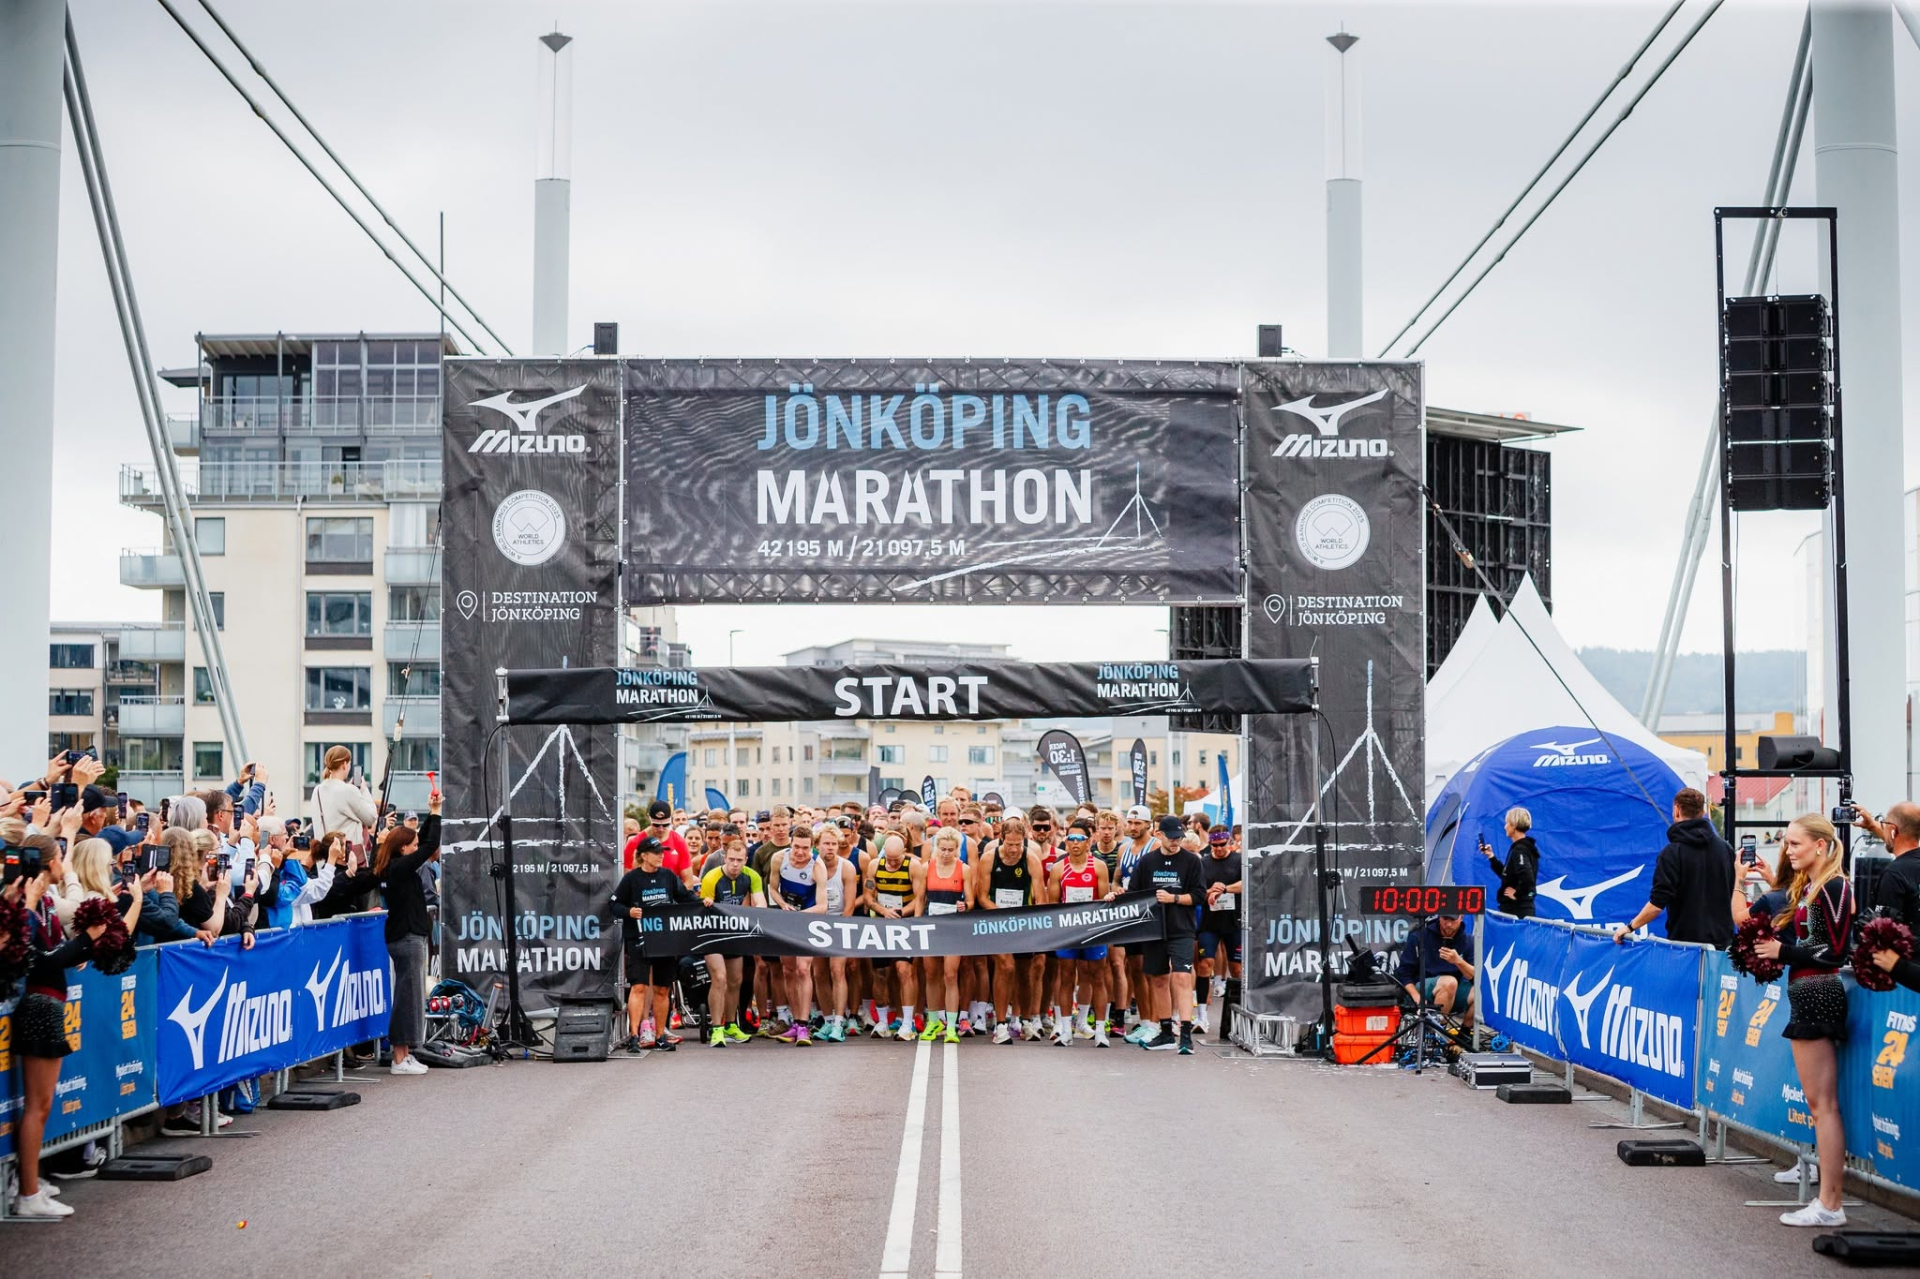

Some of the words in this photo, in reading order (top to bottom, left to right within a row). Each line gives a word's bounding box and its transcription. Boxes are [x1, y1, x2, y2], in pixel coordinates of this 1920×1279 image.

[757, 382, 1092, 450] JÖNKÖPING
[757, 469, 1092, 525] MARATHON
[827, 540, 844, 557] M
[950, 540, 966, 557] M
[492, 591, 598, 604] DESTINATION
[1297, 595, 1403, 608] DESTINATION
[492, 606, 581, 622] JÖNKÖPING
[1297, 610, 1387, 626] JÖNKÖPING
[616, 669, 698, 686] JÖNKÖPING
[1097, 662, 1179, 680] JÖNKÖPING
[616, 689, 699, 704] MARATHON
[834, 676, 988, 717] START
[1097, 682, 1179, 698] MARATHON
[669, 915, 749, 931] MARATHON
[972, 915, 1053, 935] JÖNKÖPING
[1058, 904, 1140, 928] MARATHON
[807, 920, 936, 950] START
[121, 990, 135, 1021] 24
[1749, 998, 1777, 1028] 24
